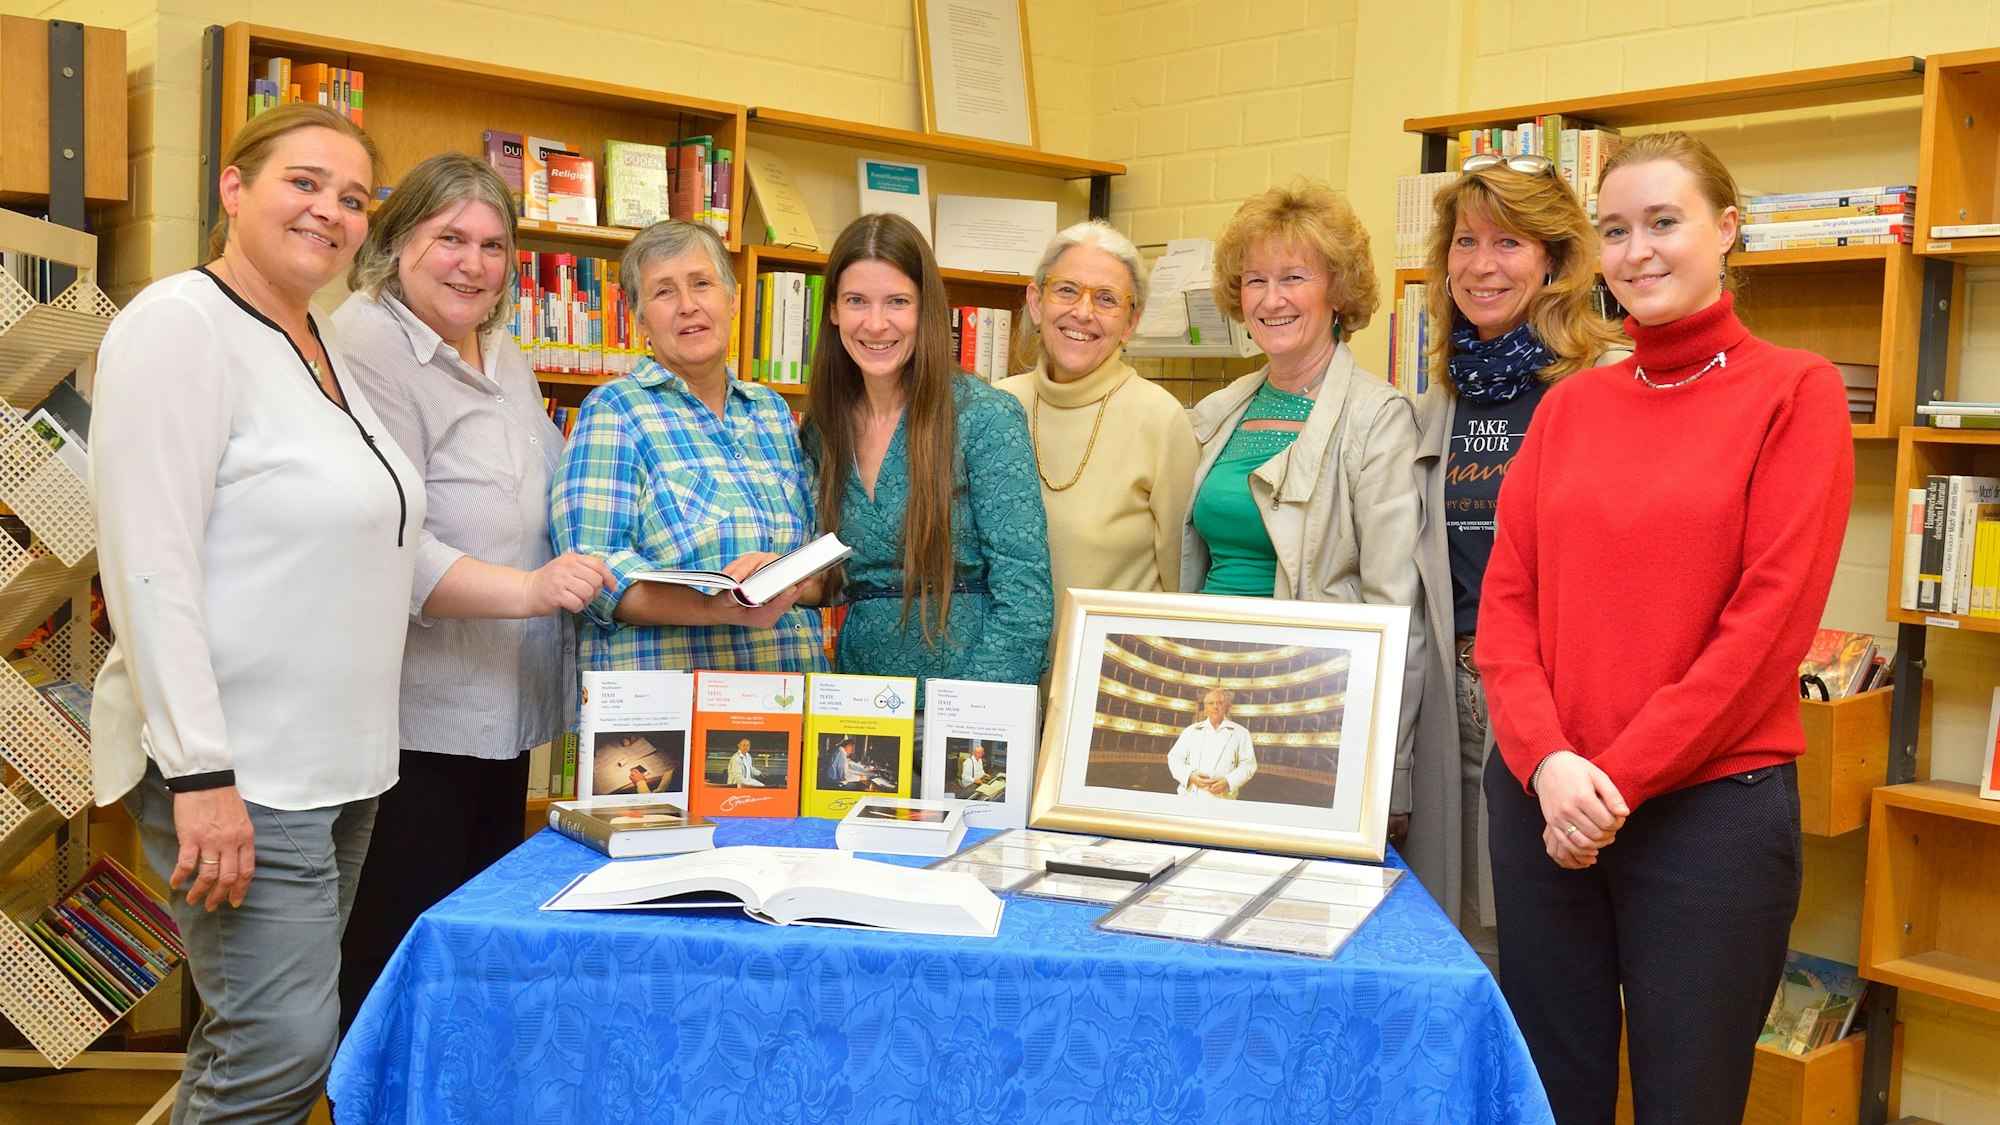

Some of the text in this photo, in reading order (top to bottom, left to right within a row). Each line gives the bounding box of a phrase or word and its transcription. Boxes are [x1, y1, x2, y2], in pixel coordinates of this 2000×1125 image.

[1522, 131, 1530, 155] Malen
[624, 154, 662, 167] DUDEN
[551, 168, 592, 182] Religion
[1881, 205, 1902, 214] TOPP
[1832, 219, 1848, 228] große
[1849, 217, 1889, 226] Aquarellschule
[1468, 420, 1508, 435] TAKE
[1463, 436, 1510, 453] YOUR
[1474, 500, 1486, 509] BE
[1924, 492, 1937, 529] Hauptwerke
[1933, 482, 1947, 540] deutschen Literatur
[1808, 968, 1858, 993] MONET
